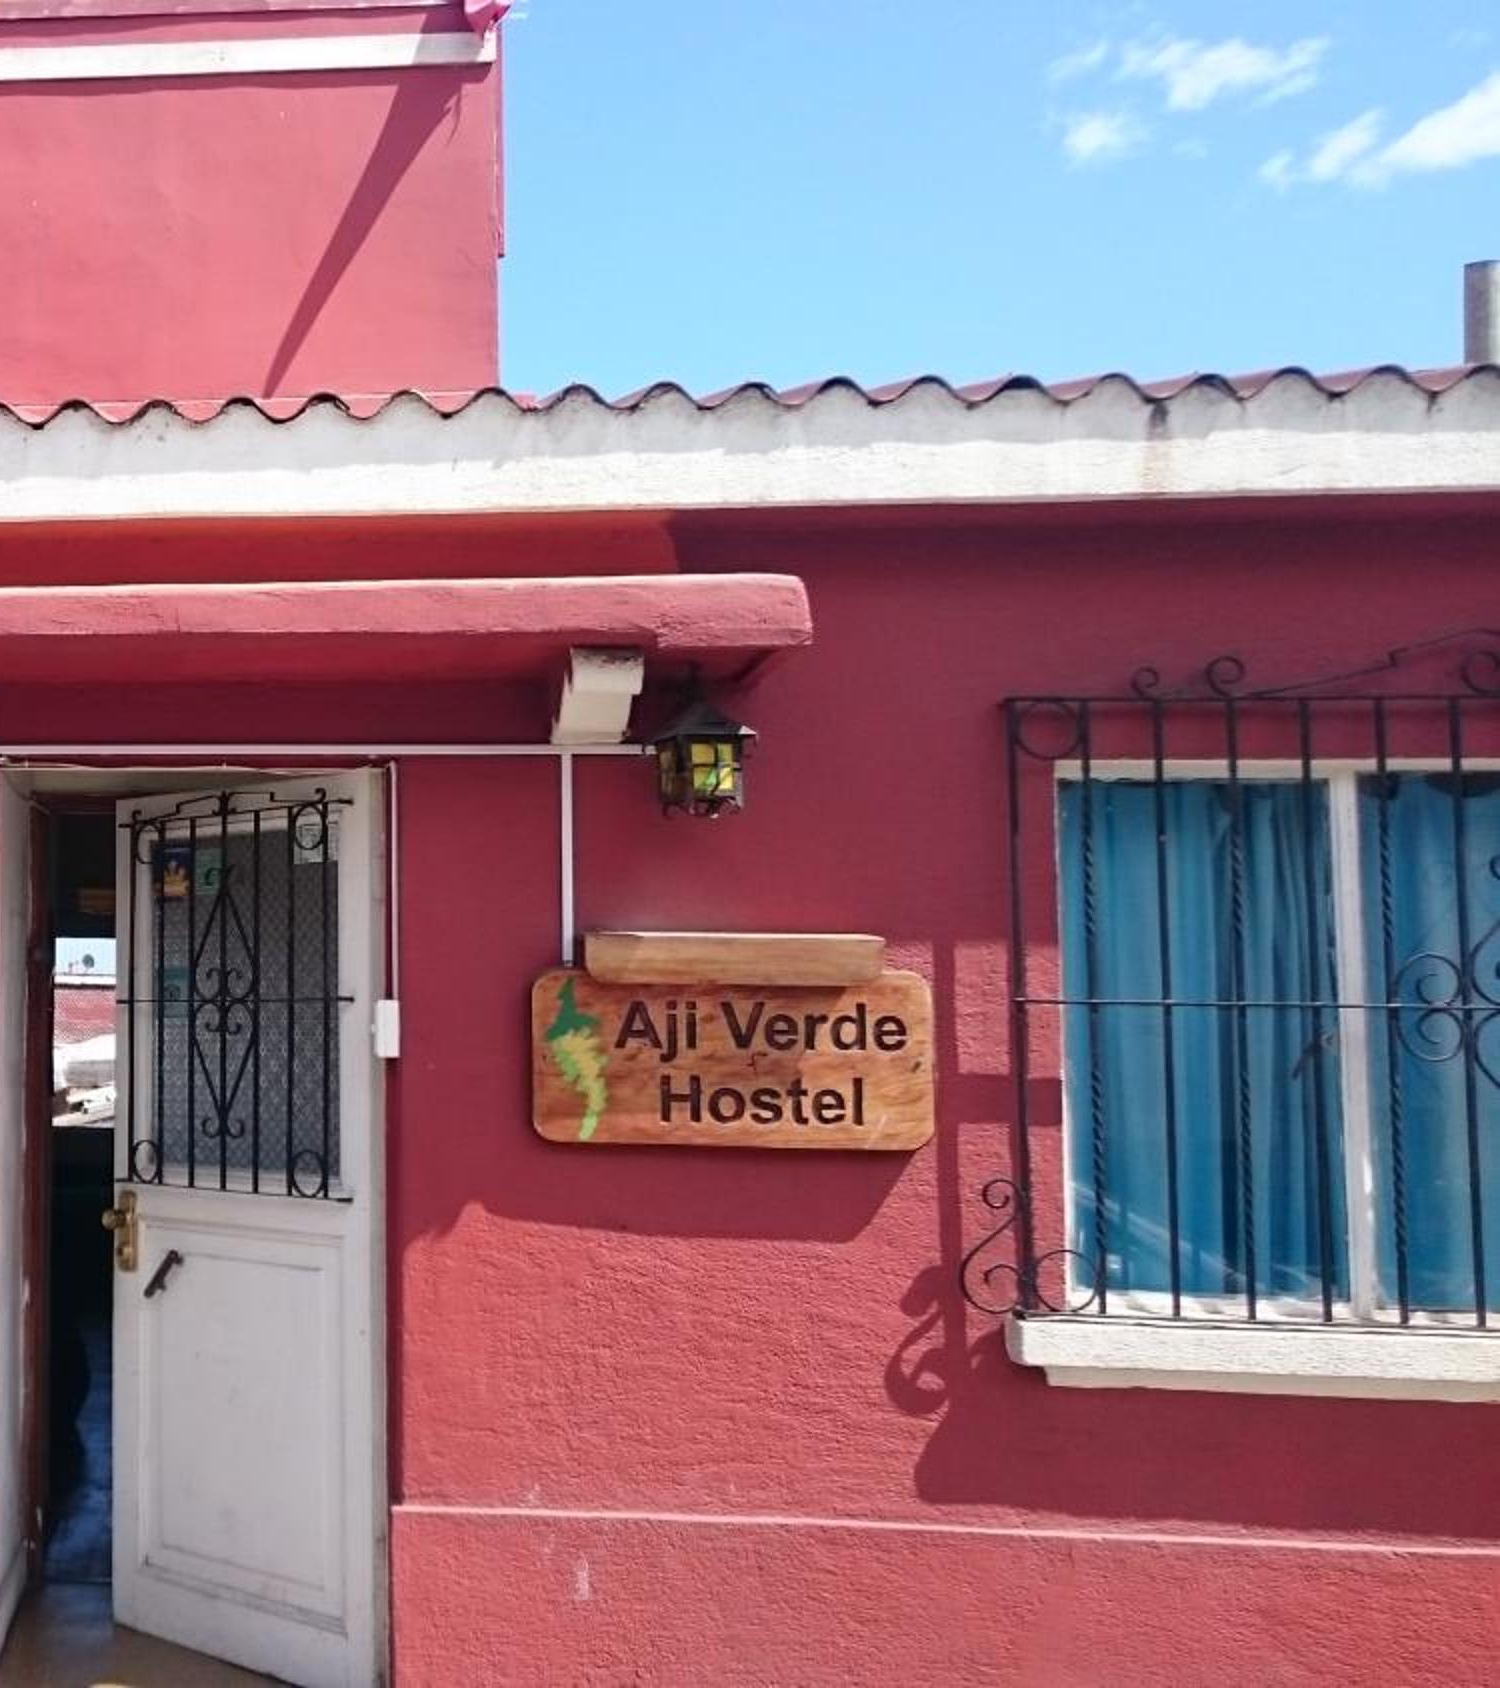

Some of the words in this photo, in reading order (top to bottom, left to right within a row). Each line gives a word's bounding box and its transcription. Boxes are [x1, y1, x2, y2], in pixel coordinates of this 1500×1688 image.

[614, 1000, 697, 1063] Aji
[720, 1001, 908, 1052] Verde
[659, 1074, 864, 1127] Hostel
